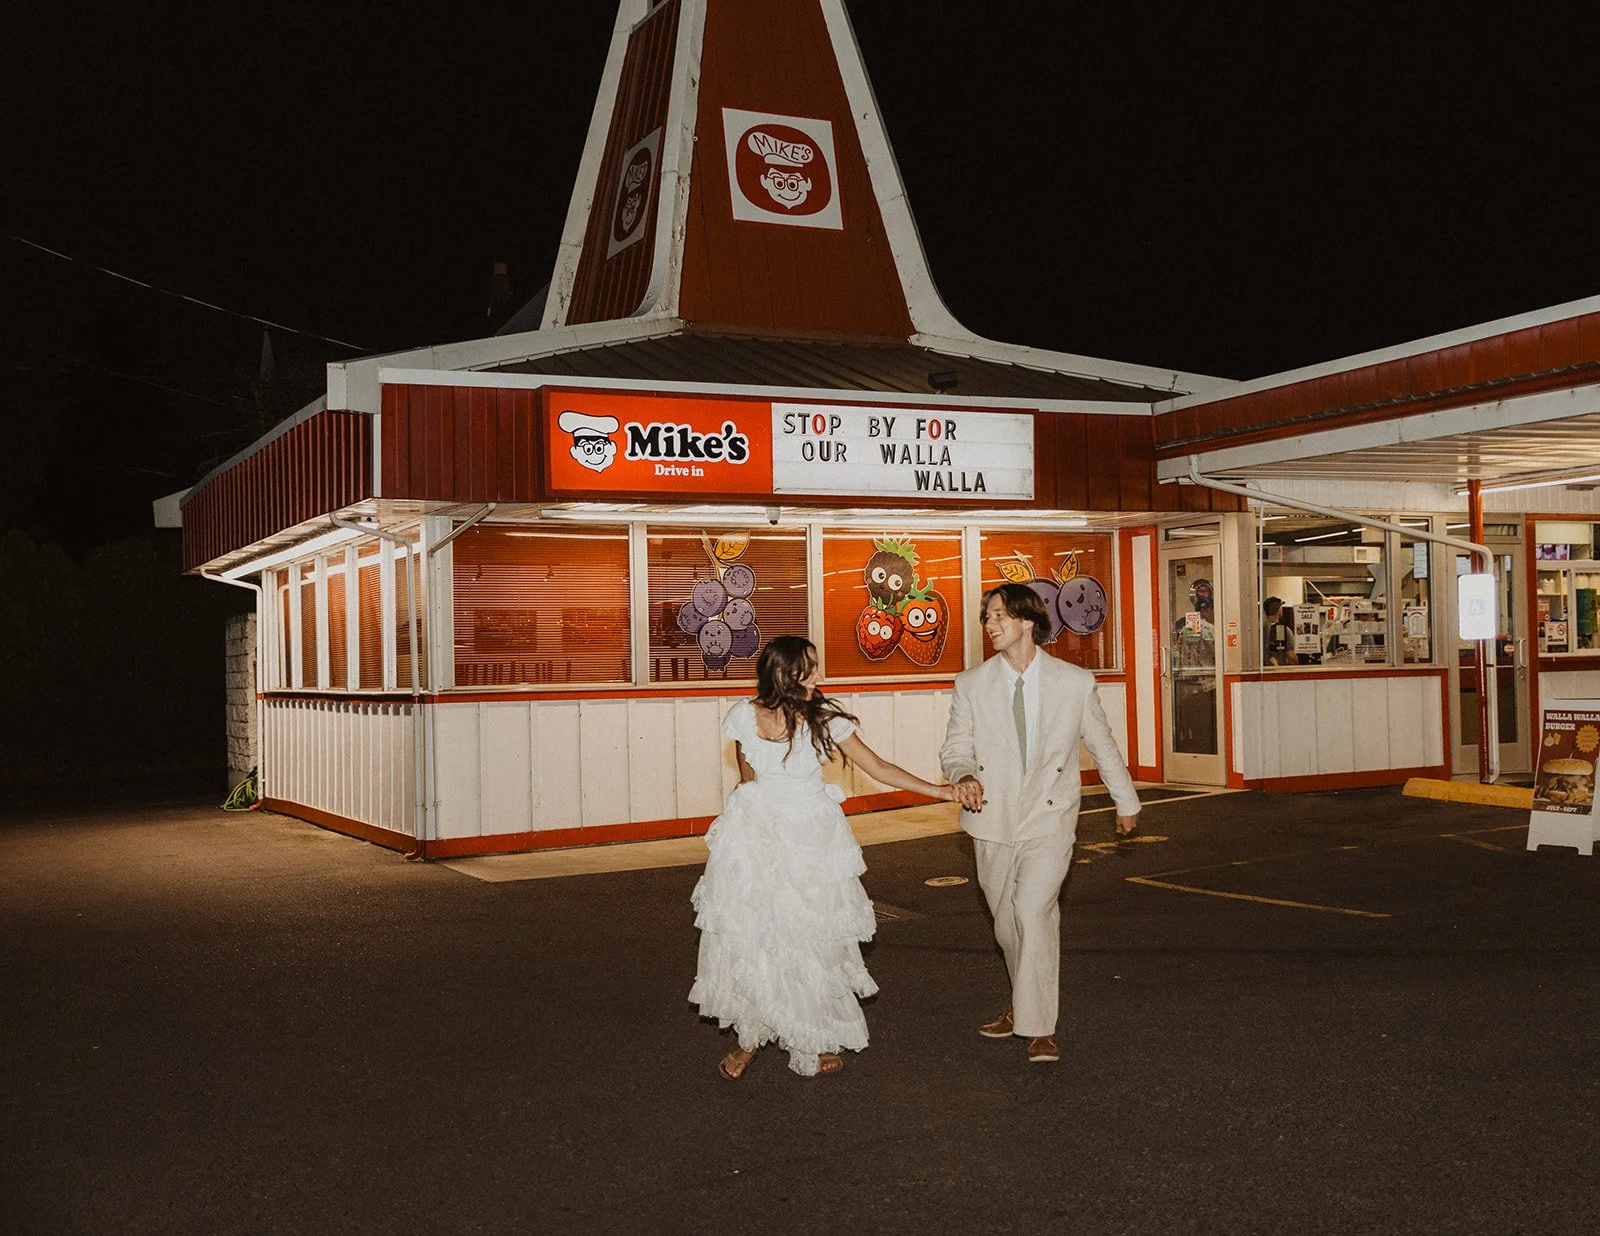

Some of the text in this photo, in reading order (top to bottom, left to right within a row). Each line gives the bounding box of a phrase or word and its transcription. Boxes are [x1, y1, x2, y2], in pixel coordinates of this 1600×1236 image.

[752, 132, 812, 162] MIKE'S
[783, 412, 957, 440] STOP BY FOR
[626, 422, 748, 463] Mike's
[802, 440, 952, 466] OUR WALLA
[654, 464, 704, 477] Drive in
[914, 470, 986, 492] WALLA
[1545, 723, 1576, 731] BURGER
[1546, 713, 1600, 722] WALLA WALLA
